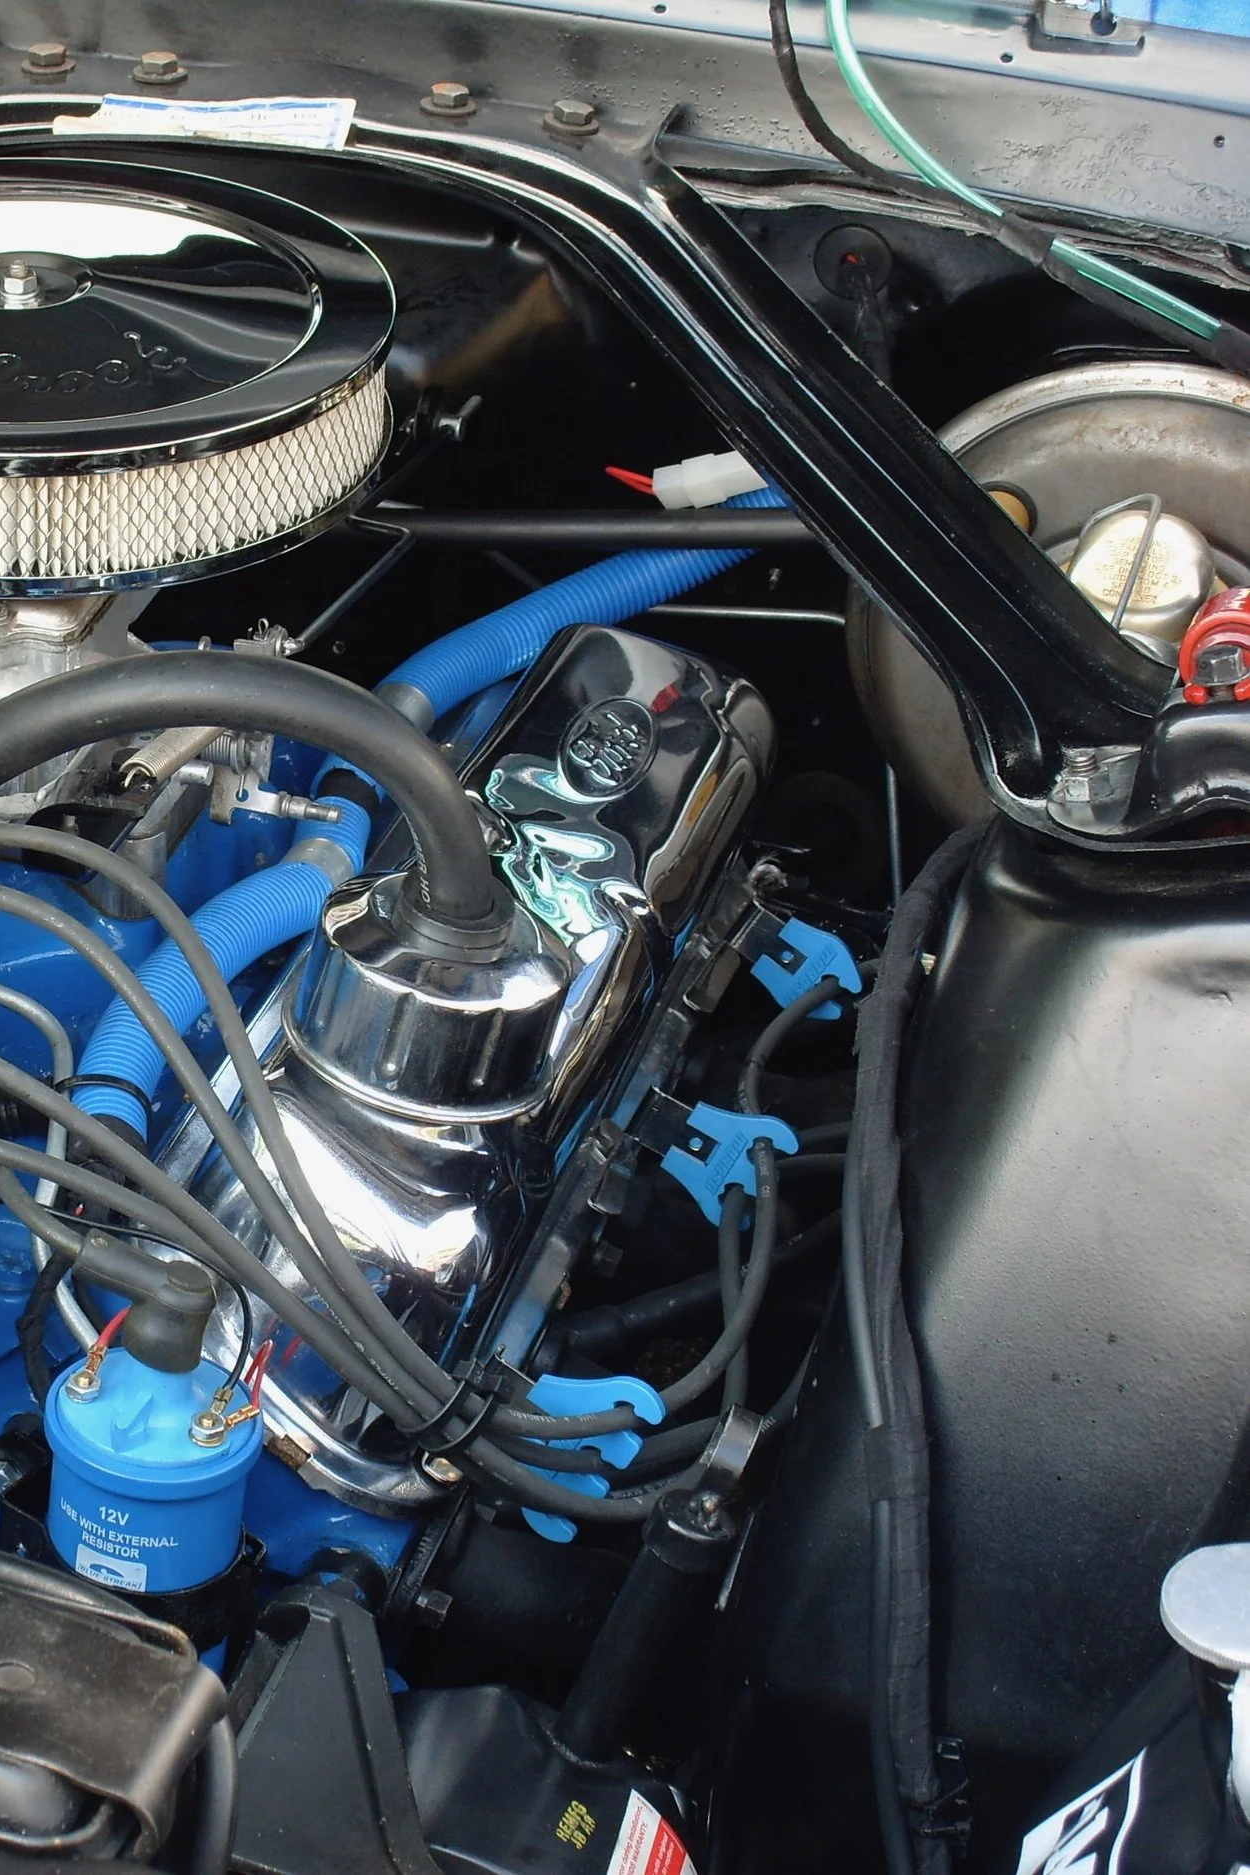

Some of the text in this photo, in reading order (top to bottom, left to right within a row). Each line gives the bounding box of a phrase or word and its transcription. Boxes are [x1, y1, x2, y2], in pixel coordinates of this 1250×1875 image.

[59, 1496, 179, 1548] USE WITH EXTERNAL
[98, 1505, 130, 1526] 12V
[81, 1531, 140, 1560] RESISTOR
